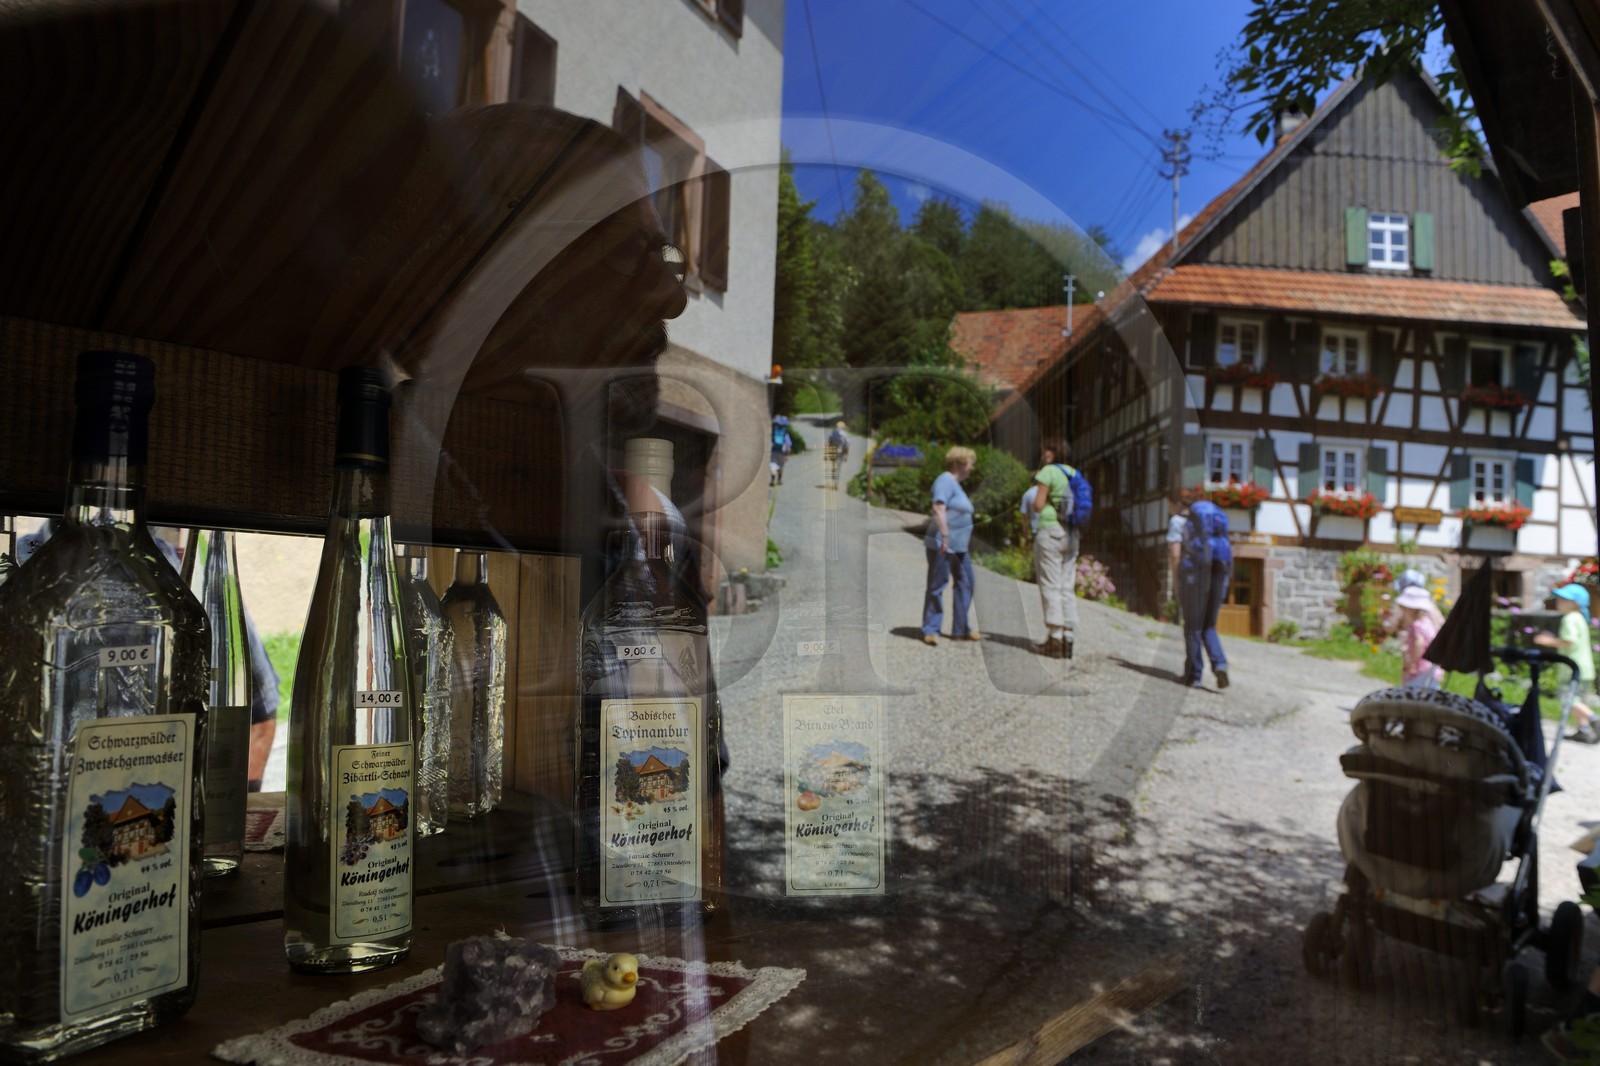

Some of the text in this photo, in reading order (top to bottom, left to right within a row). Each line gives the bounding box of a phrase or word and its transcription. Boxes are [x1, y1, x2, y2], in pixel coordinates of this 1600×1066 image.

[140, 648, 148, 659] €
[624, 646, 656, 657] 9,00 €
[361, 693, 401, 704] 14,00 €
[628, 710, 676, 721] Badischer
[823, 704, 844, 715] Edel
[794, 718, 874, 730] Birnen-Brand
[612, 724, 689, 741] Topinambur
[88, 731, 176, 751] Schwarzwälder
[76, 752, 184, 775] Zwetschgenwasser
[351, 758, 406, 770] Schwarzwälder
[342, 769, 410, 785] Zibärtli-Schnaps
[822, 811, 854, 821] Original
[638, 819, 671, 831] Original
[796, 815, 875, 838] Köningerhof
[611, 823, 693, 848] Köningerhof
[367, 855, 397, 869] Original
[340, 856, 410, 887] Köningerhof
[827, 869, 839, 878] 0,7
[643, 880, 655, 889] 0,7
[108, 882, 150, 904] Original
[358, 889, 378, 898] Rudolf
[73, 883, 176, 935] Köningerhof
[372, 914, 383, 924] 0,5
[96, 934, 122, 947] Familie
[113, 969, 128, 983] 0,7
